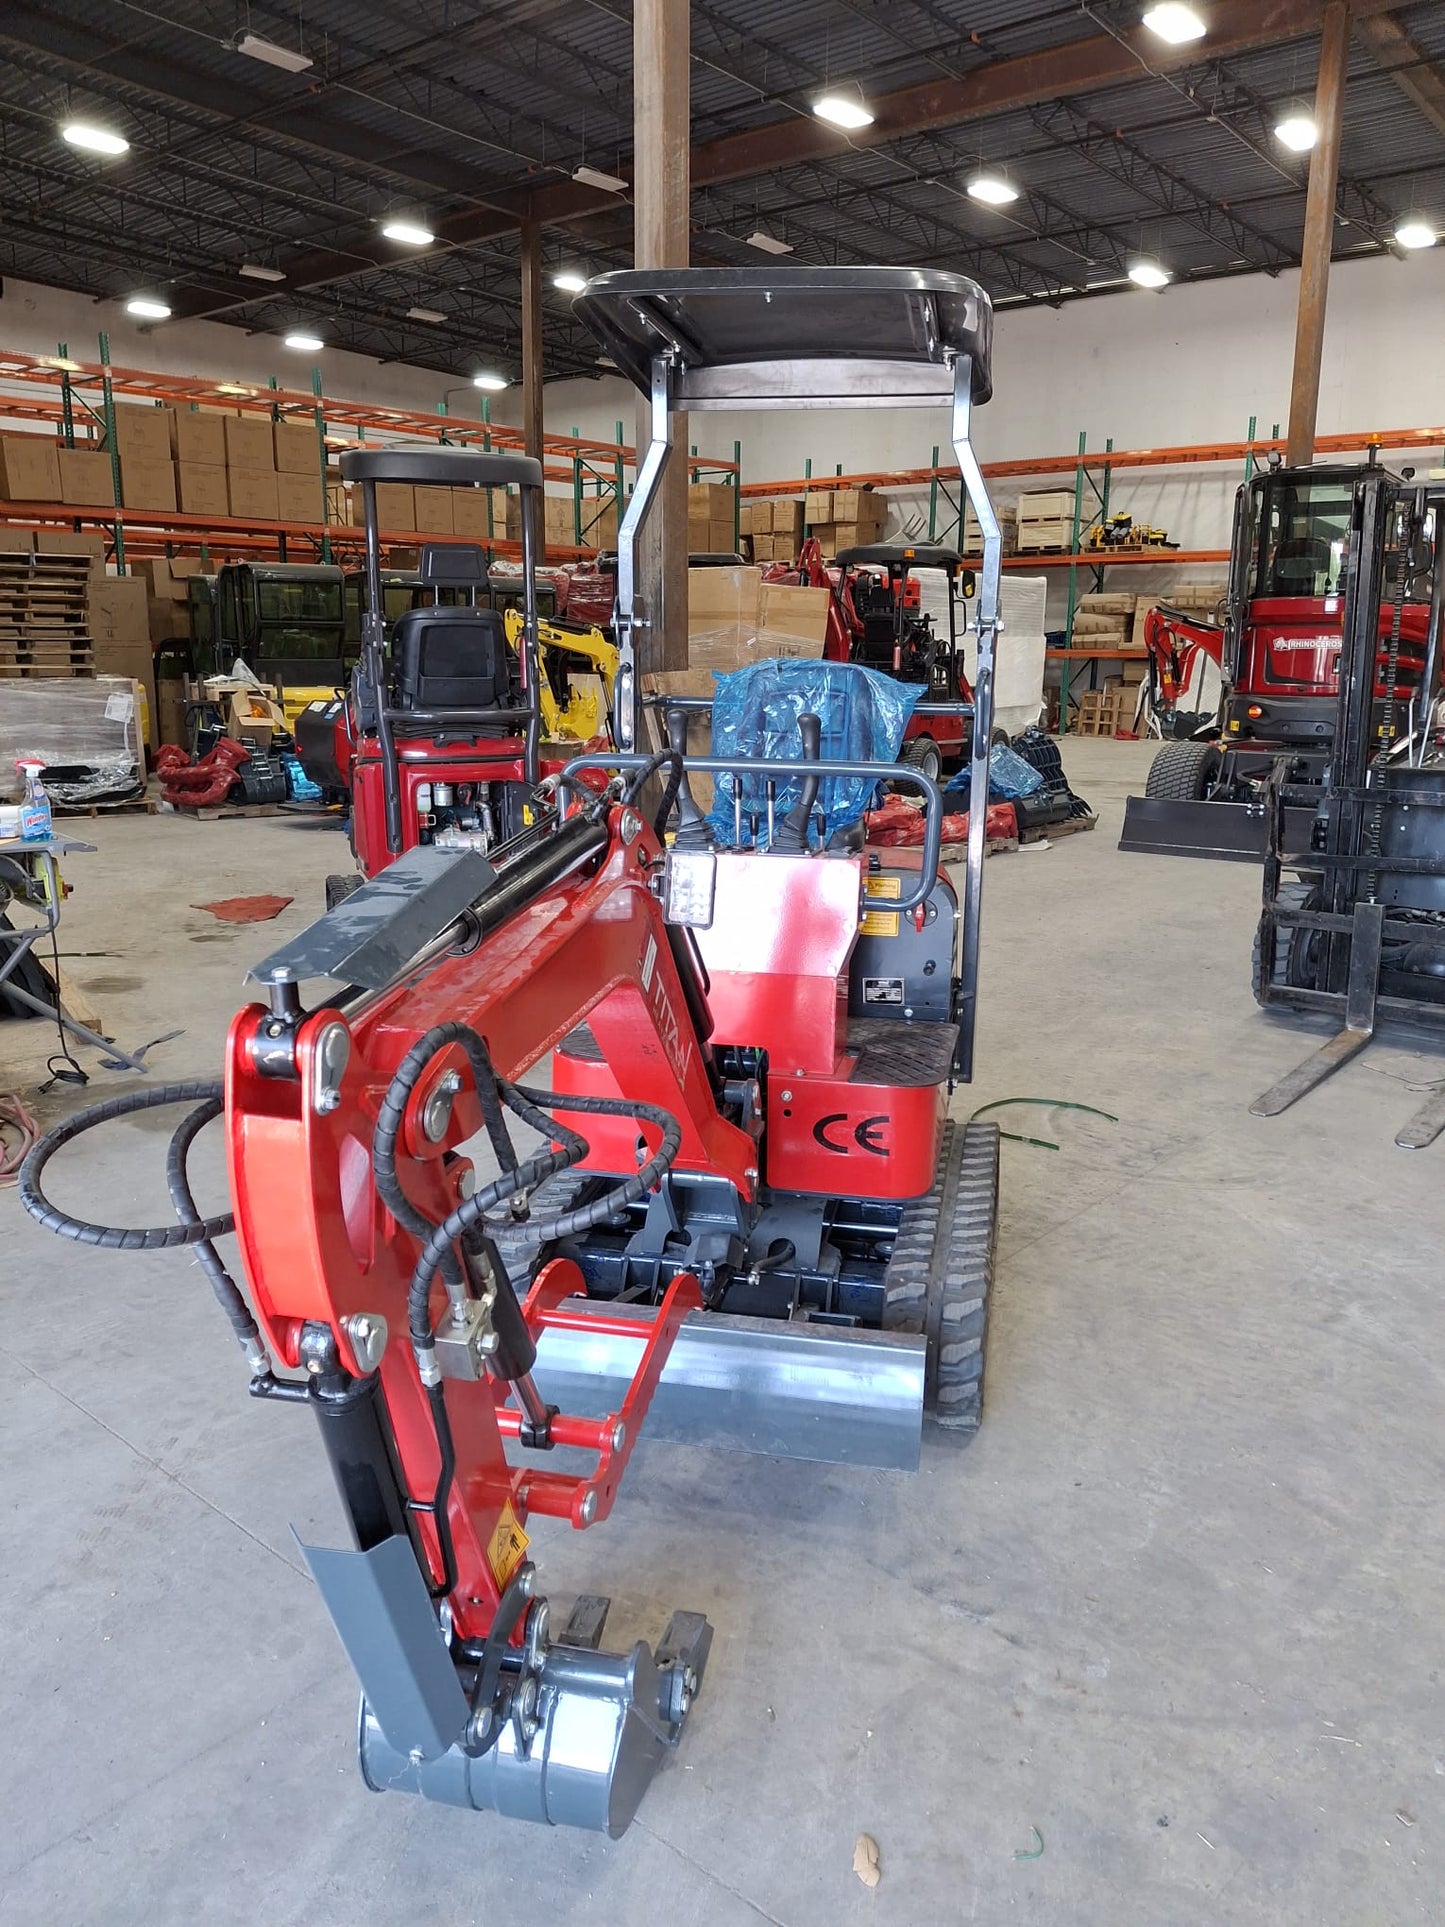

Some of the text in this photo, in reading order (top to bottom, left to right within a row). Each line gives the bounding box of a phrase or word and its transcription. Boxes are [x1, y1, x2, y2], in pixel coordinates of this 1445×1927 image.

[1289, 639, 1343, 649] RHINOCEROS
[655, 969, 693, 1083] TITAN
[812, 1112, 890, 1157] CE
